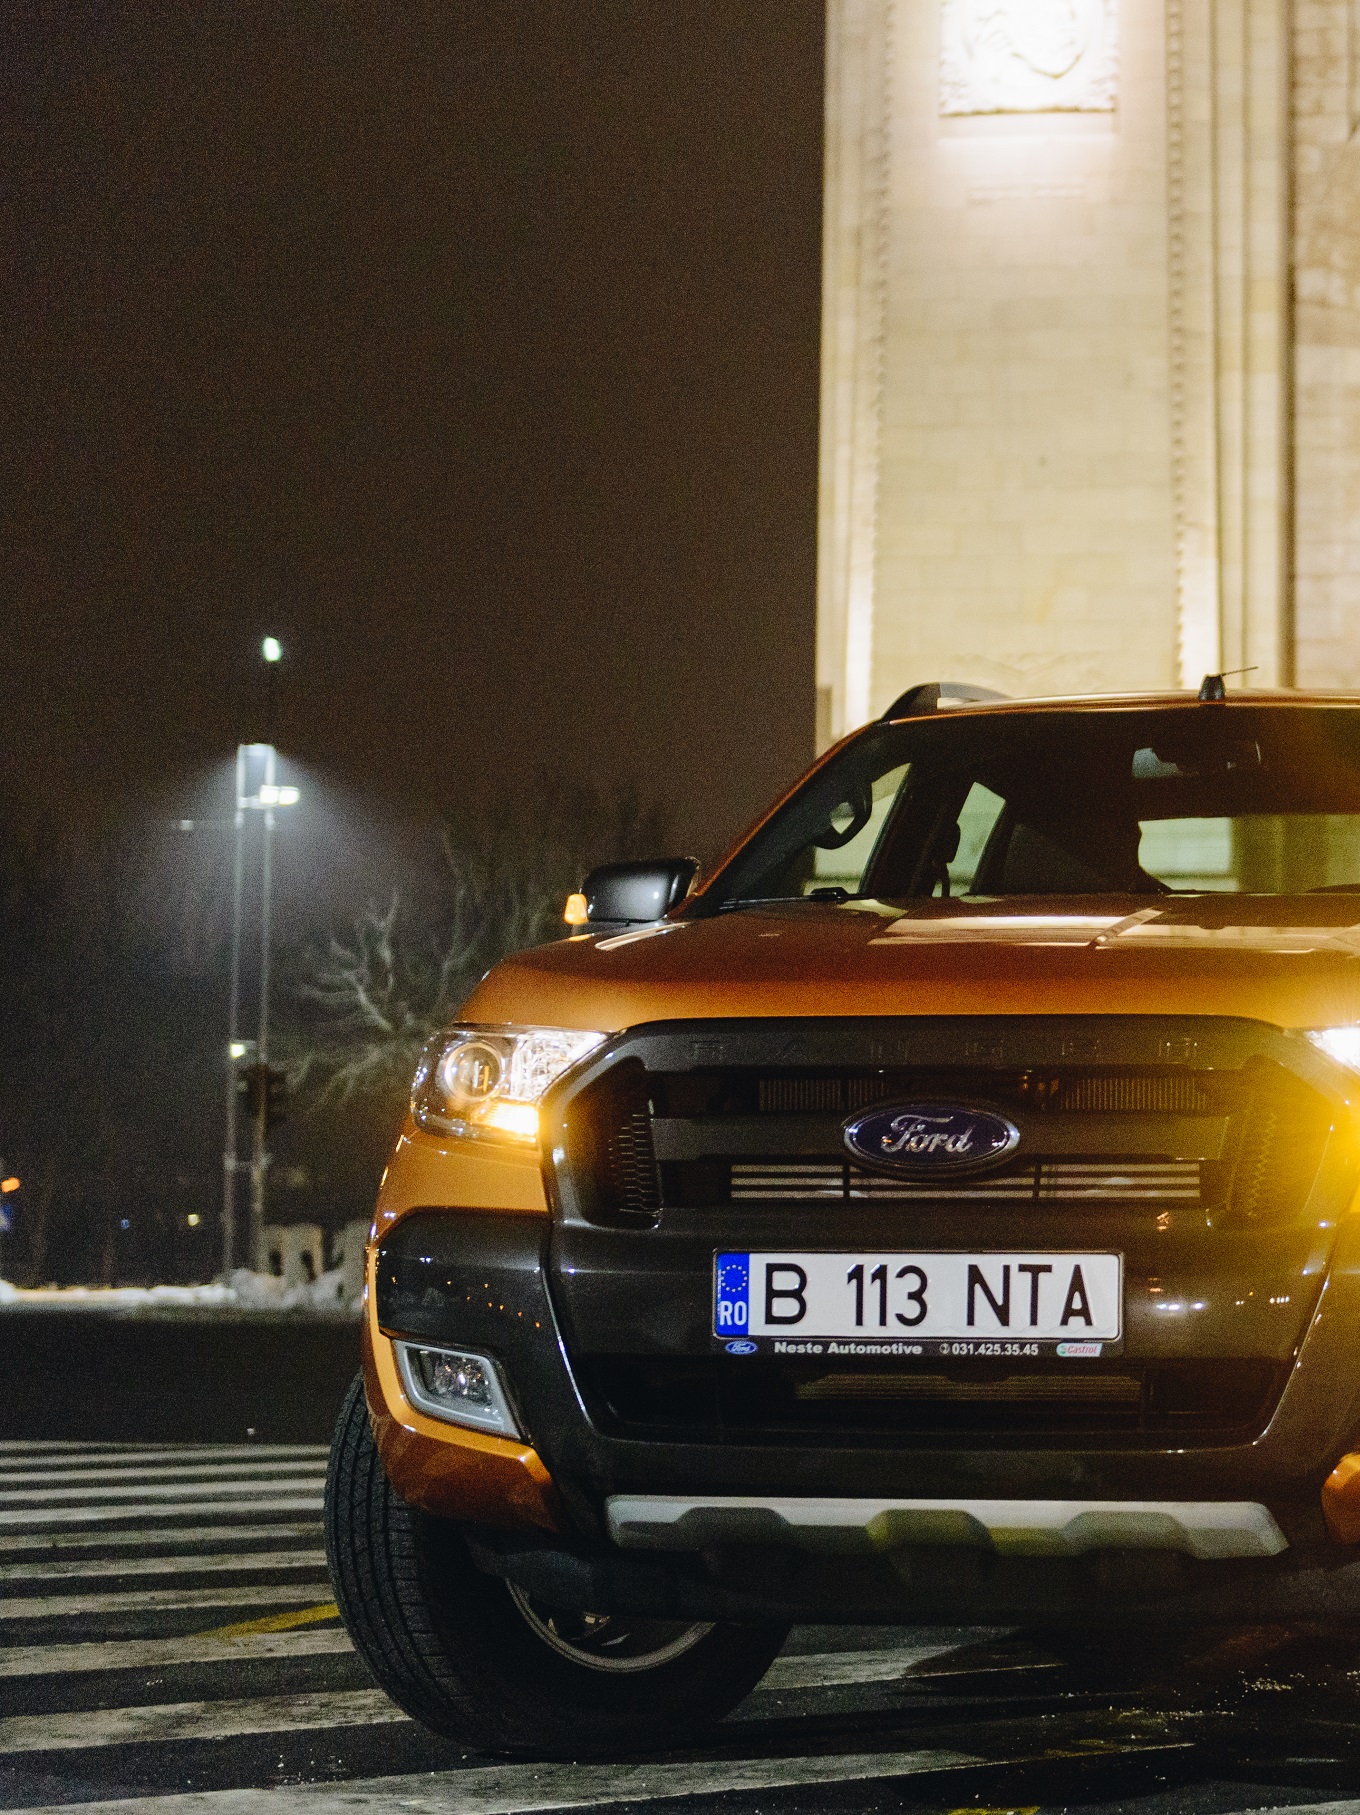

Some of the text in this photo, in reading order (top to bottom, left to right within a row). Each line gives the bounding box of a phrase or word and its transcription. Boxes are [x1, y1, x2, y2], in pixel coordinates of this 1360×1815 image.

[881, 1115, 976, 1153] Ford
[764, 1263, 1094, 1327] B 113 NTA
[719, 1300, 748, 1326] RO
[774, 1341, 1039, 1356] Neste Automotive 031.425.35.45
[1067, 1345, 1098, 1354] Castrol
